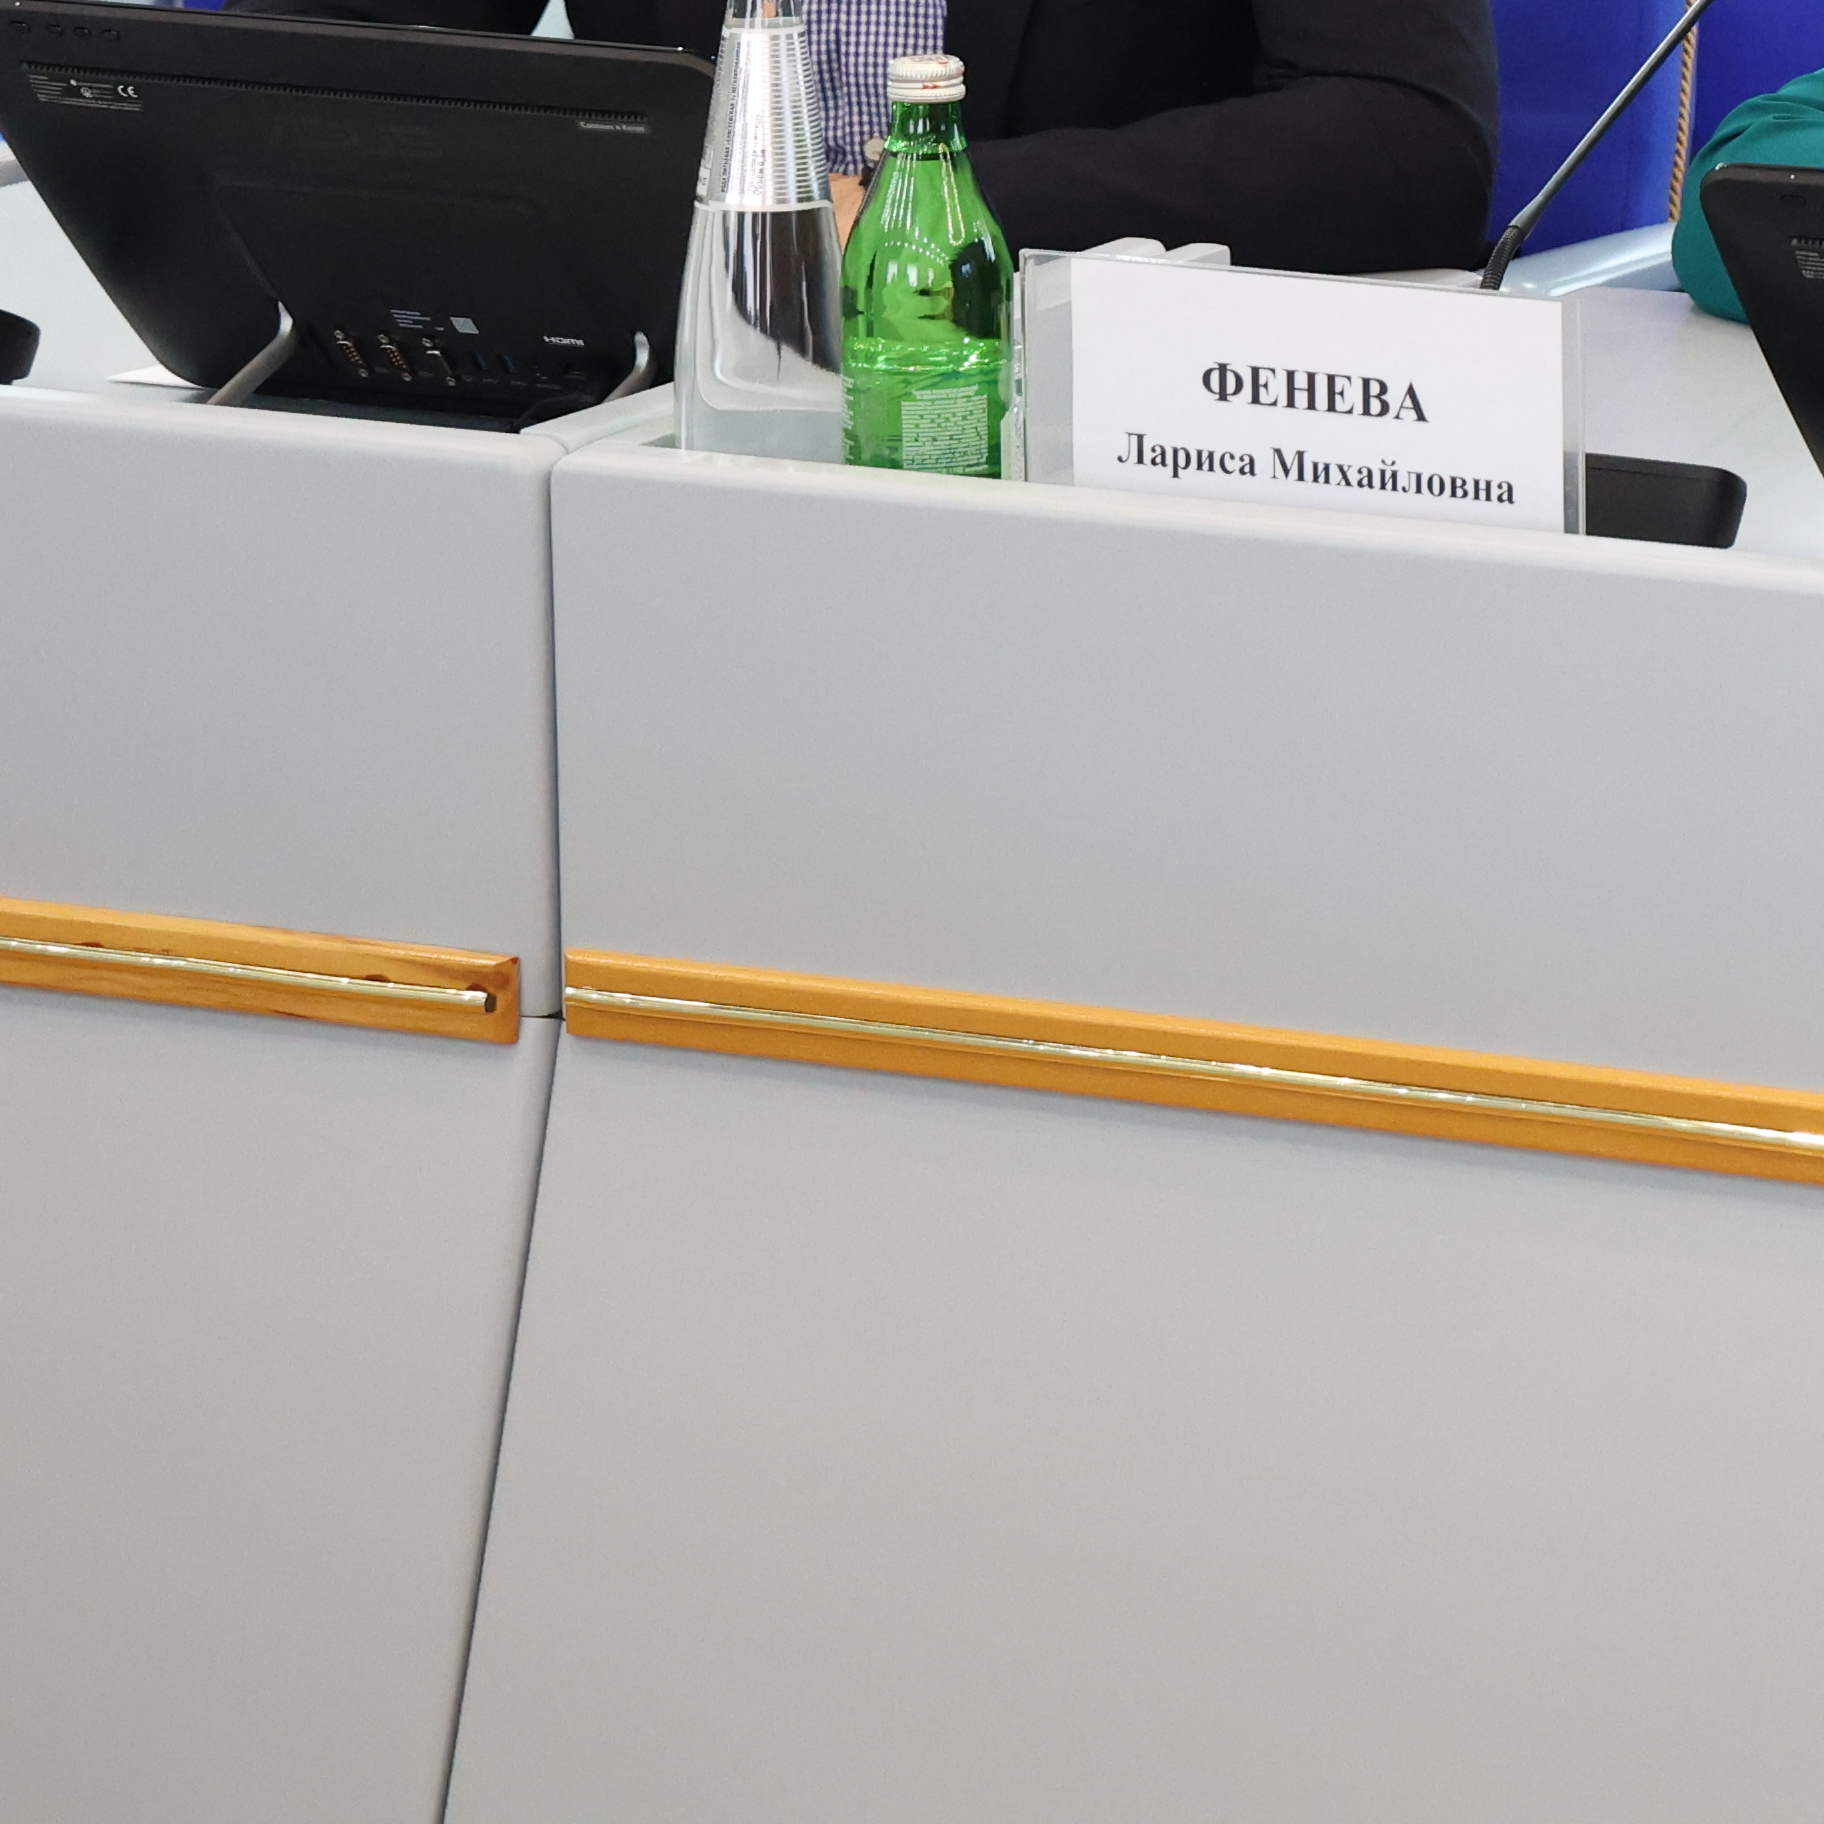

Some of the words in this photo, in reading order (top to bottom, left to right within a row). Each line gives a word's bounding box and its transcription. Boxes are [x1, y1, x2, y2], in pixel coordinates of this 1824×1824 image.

[1203, 363, 1428, 422] ФЕНЕВА
[1118, 433, 1256, 478] Лариса
[1272, 448, 1514, 504] Михайловна
